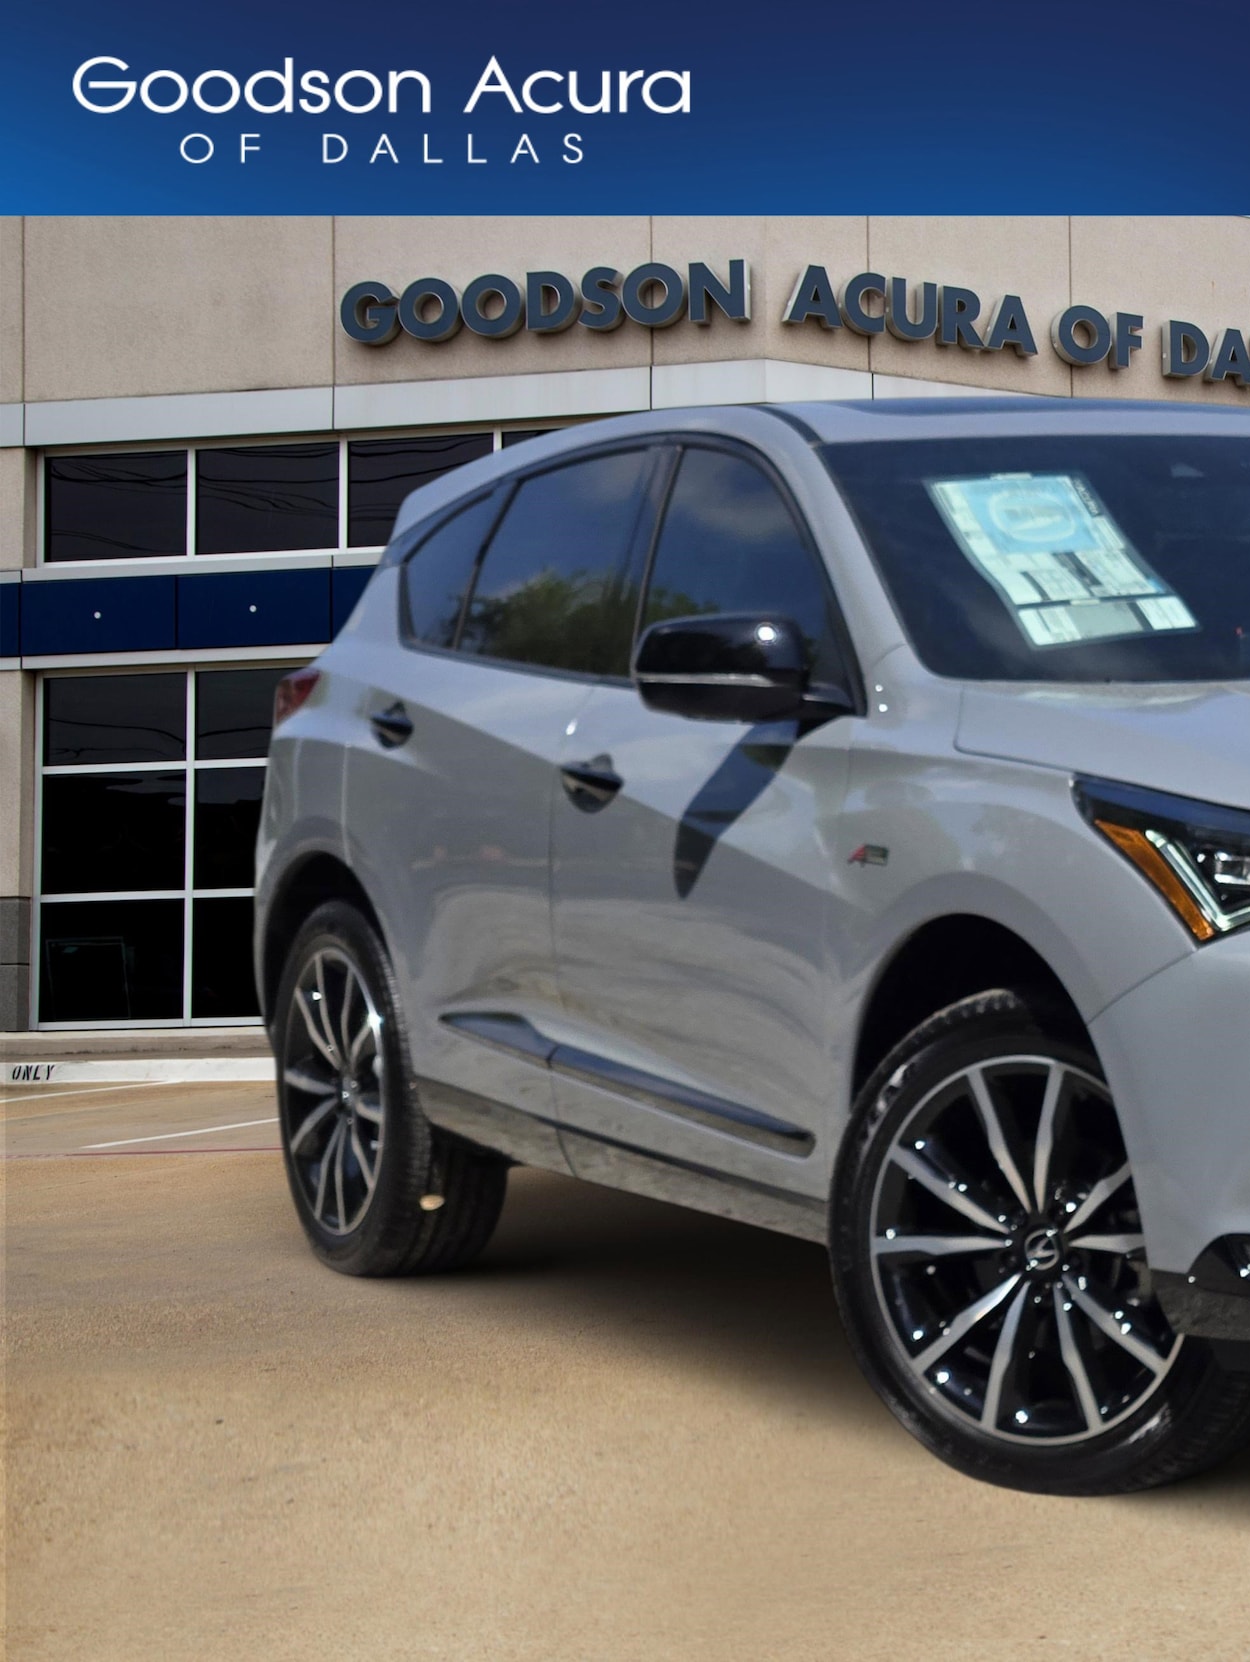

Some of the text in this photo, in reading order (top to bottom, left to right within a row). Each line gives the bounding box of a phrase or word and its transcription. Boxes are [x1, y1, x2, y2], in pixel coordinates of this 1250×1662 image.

[341, 259, 750, 346] GOODSON
[785, 265, 1038, 355] ACURA
[1054, 306, 1145, 370] OF
[12, 1064, 56, 1081] ONLY
